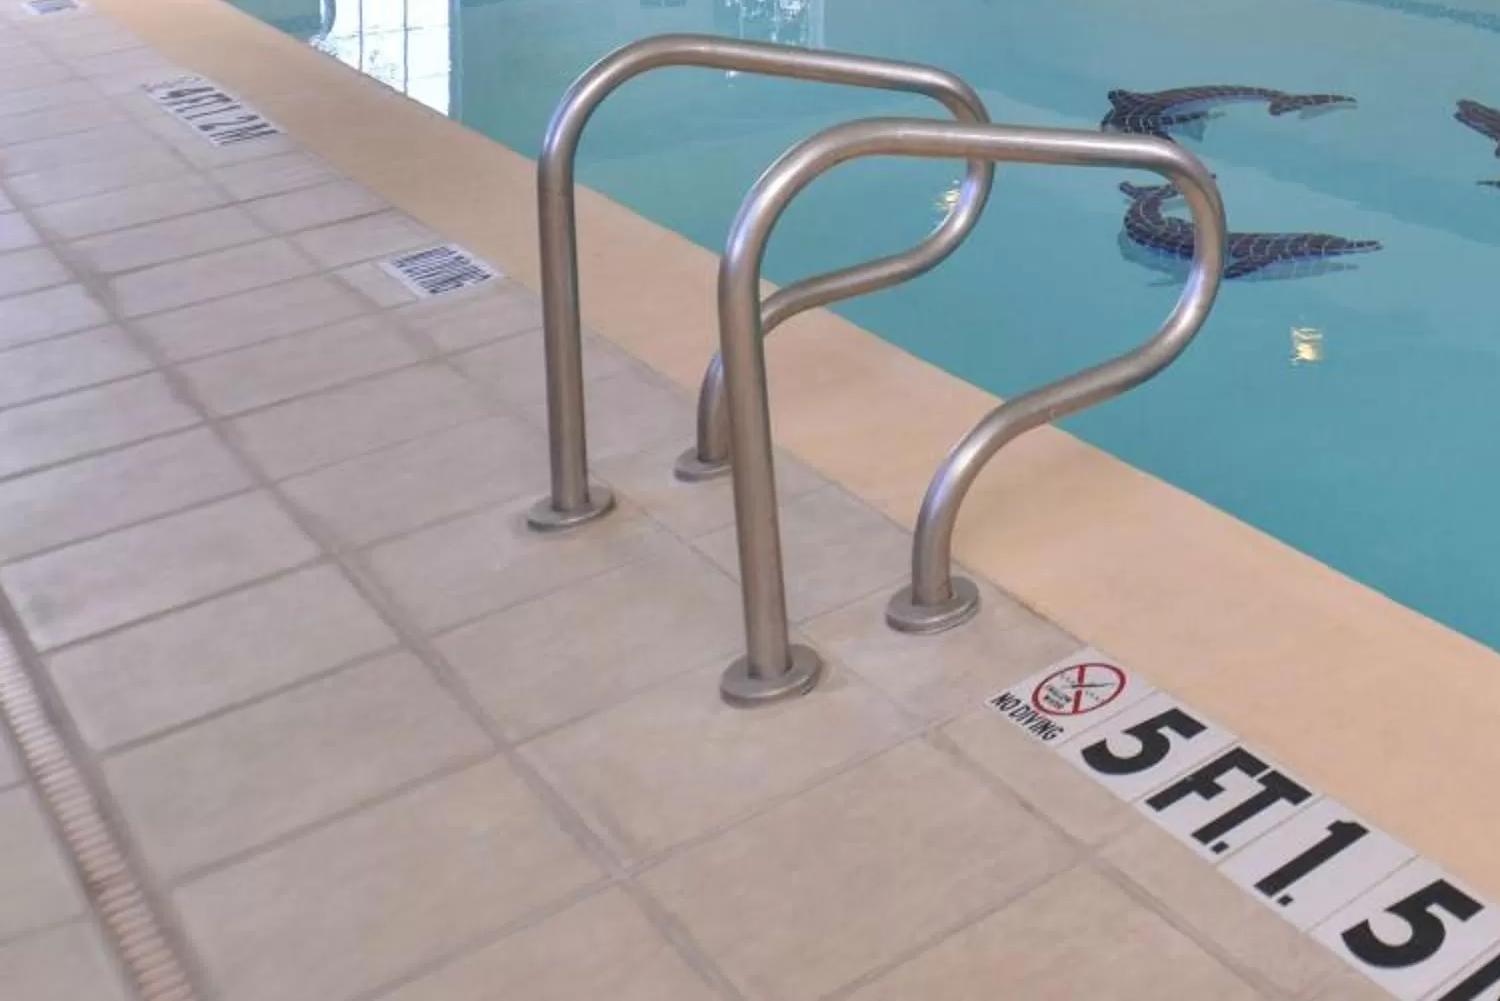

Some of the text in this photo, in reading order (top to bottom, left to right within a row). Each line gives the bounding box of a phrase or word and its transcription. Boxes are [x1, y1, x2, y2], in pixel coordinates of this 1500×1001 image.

[991, 691, 1021, 712] NO
[1007, 702, 1065, 741] DIVING
[1080, 706, 1208, 776] 5
[1341, 878, 1486, 968] 5
